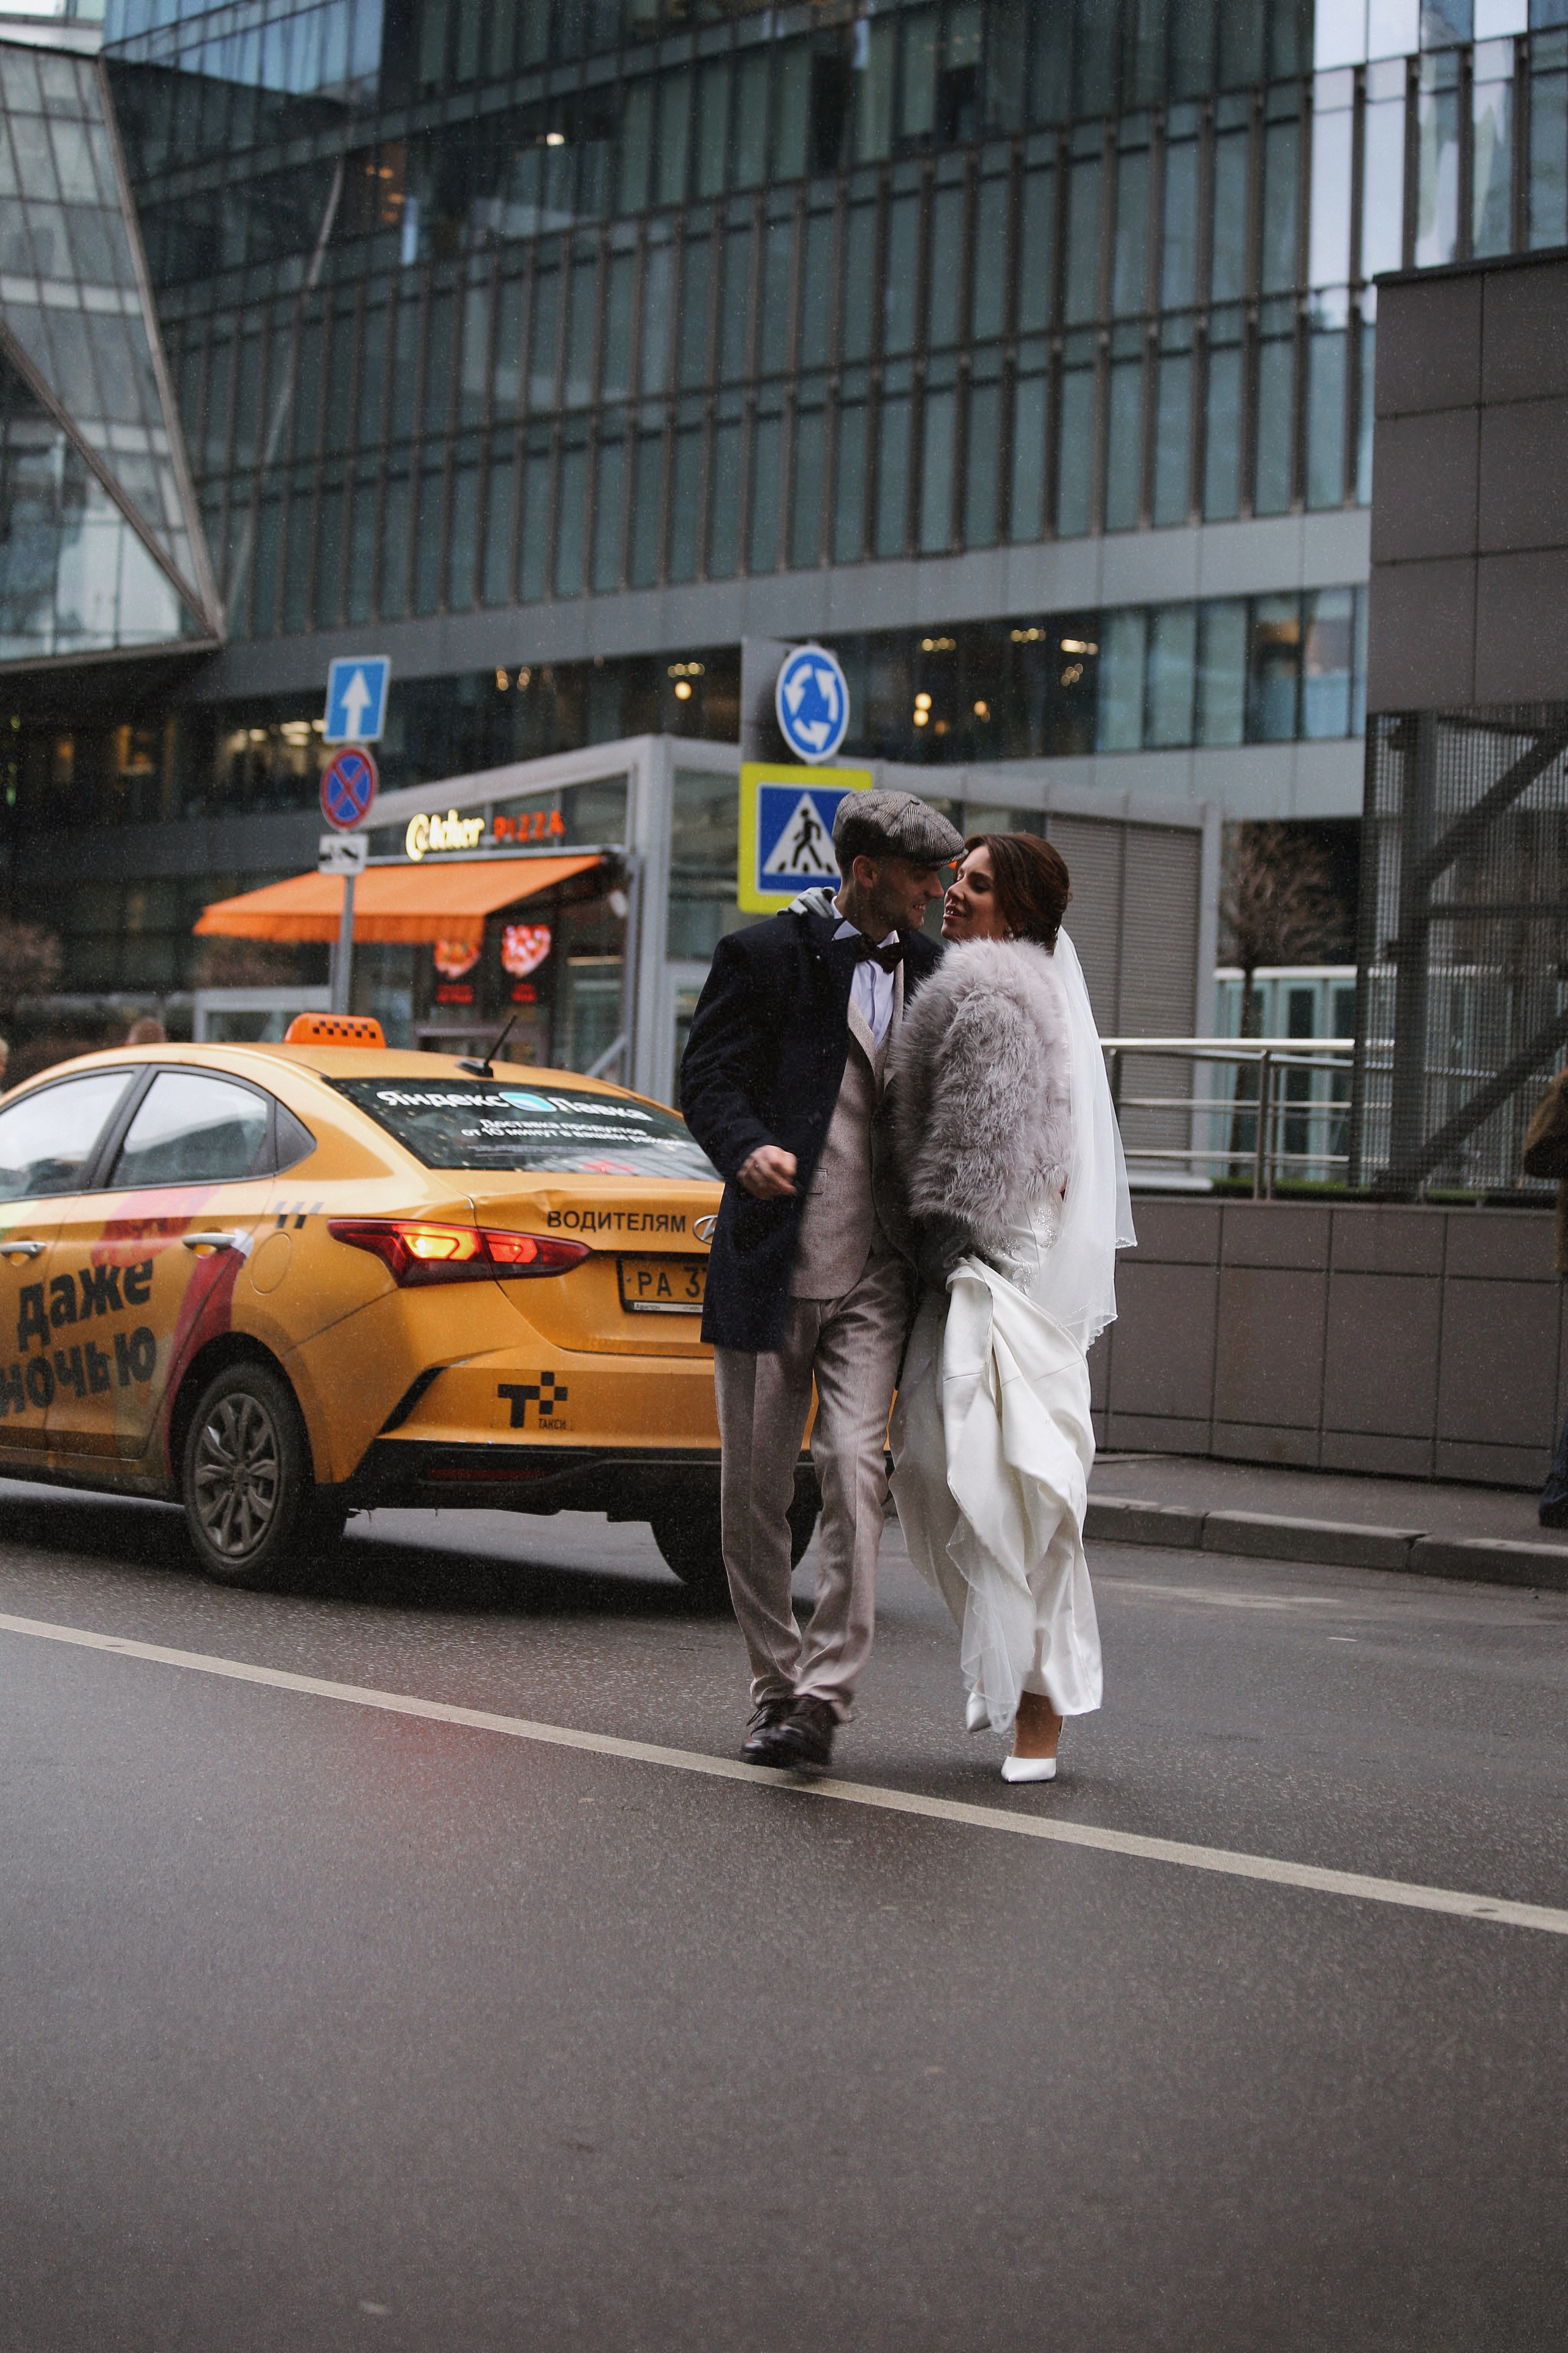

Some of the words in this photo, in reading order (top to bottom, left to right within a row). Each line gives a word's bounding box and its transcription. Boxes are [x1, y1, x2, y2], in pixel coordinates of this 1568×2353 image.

[494, 810, 565, 842] PIZZA
[376, 1090, 510, 1108] Яндекс
[481, 1127, 505, 1136] 10
[547, 1210, 685, 1233] ВОДИТЕЛЯМ
[0, 1327, 157, 1417] ночью
